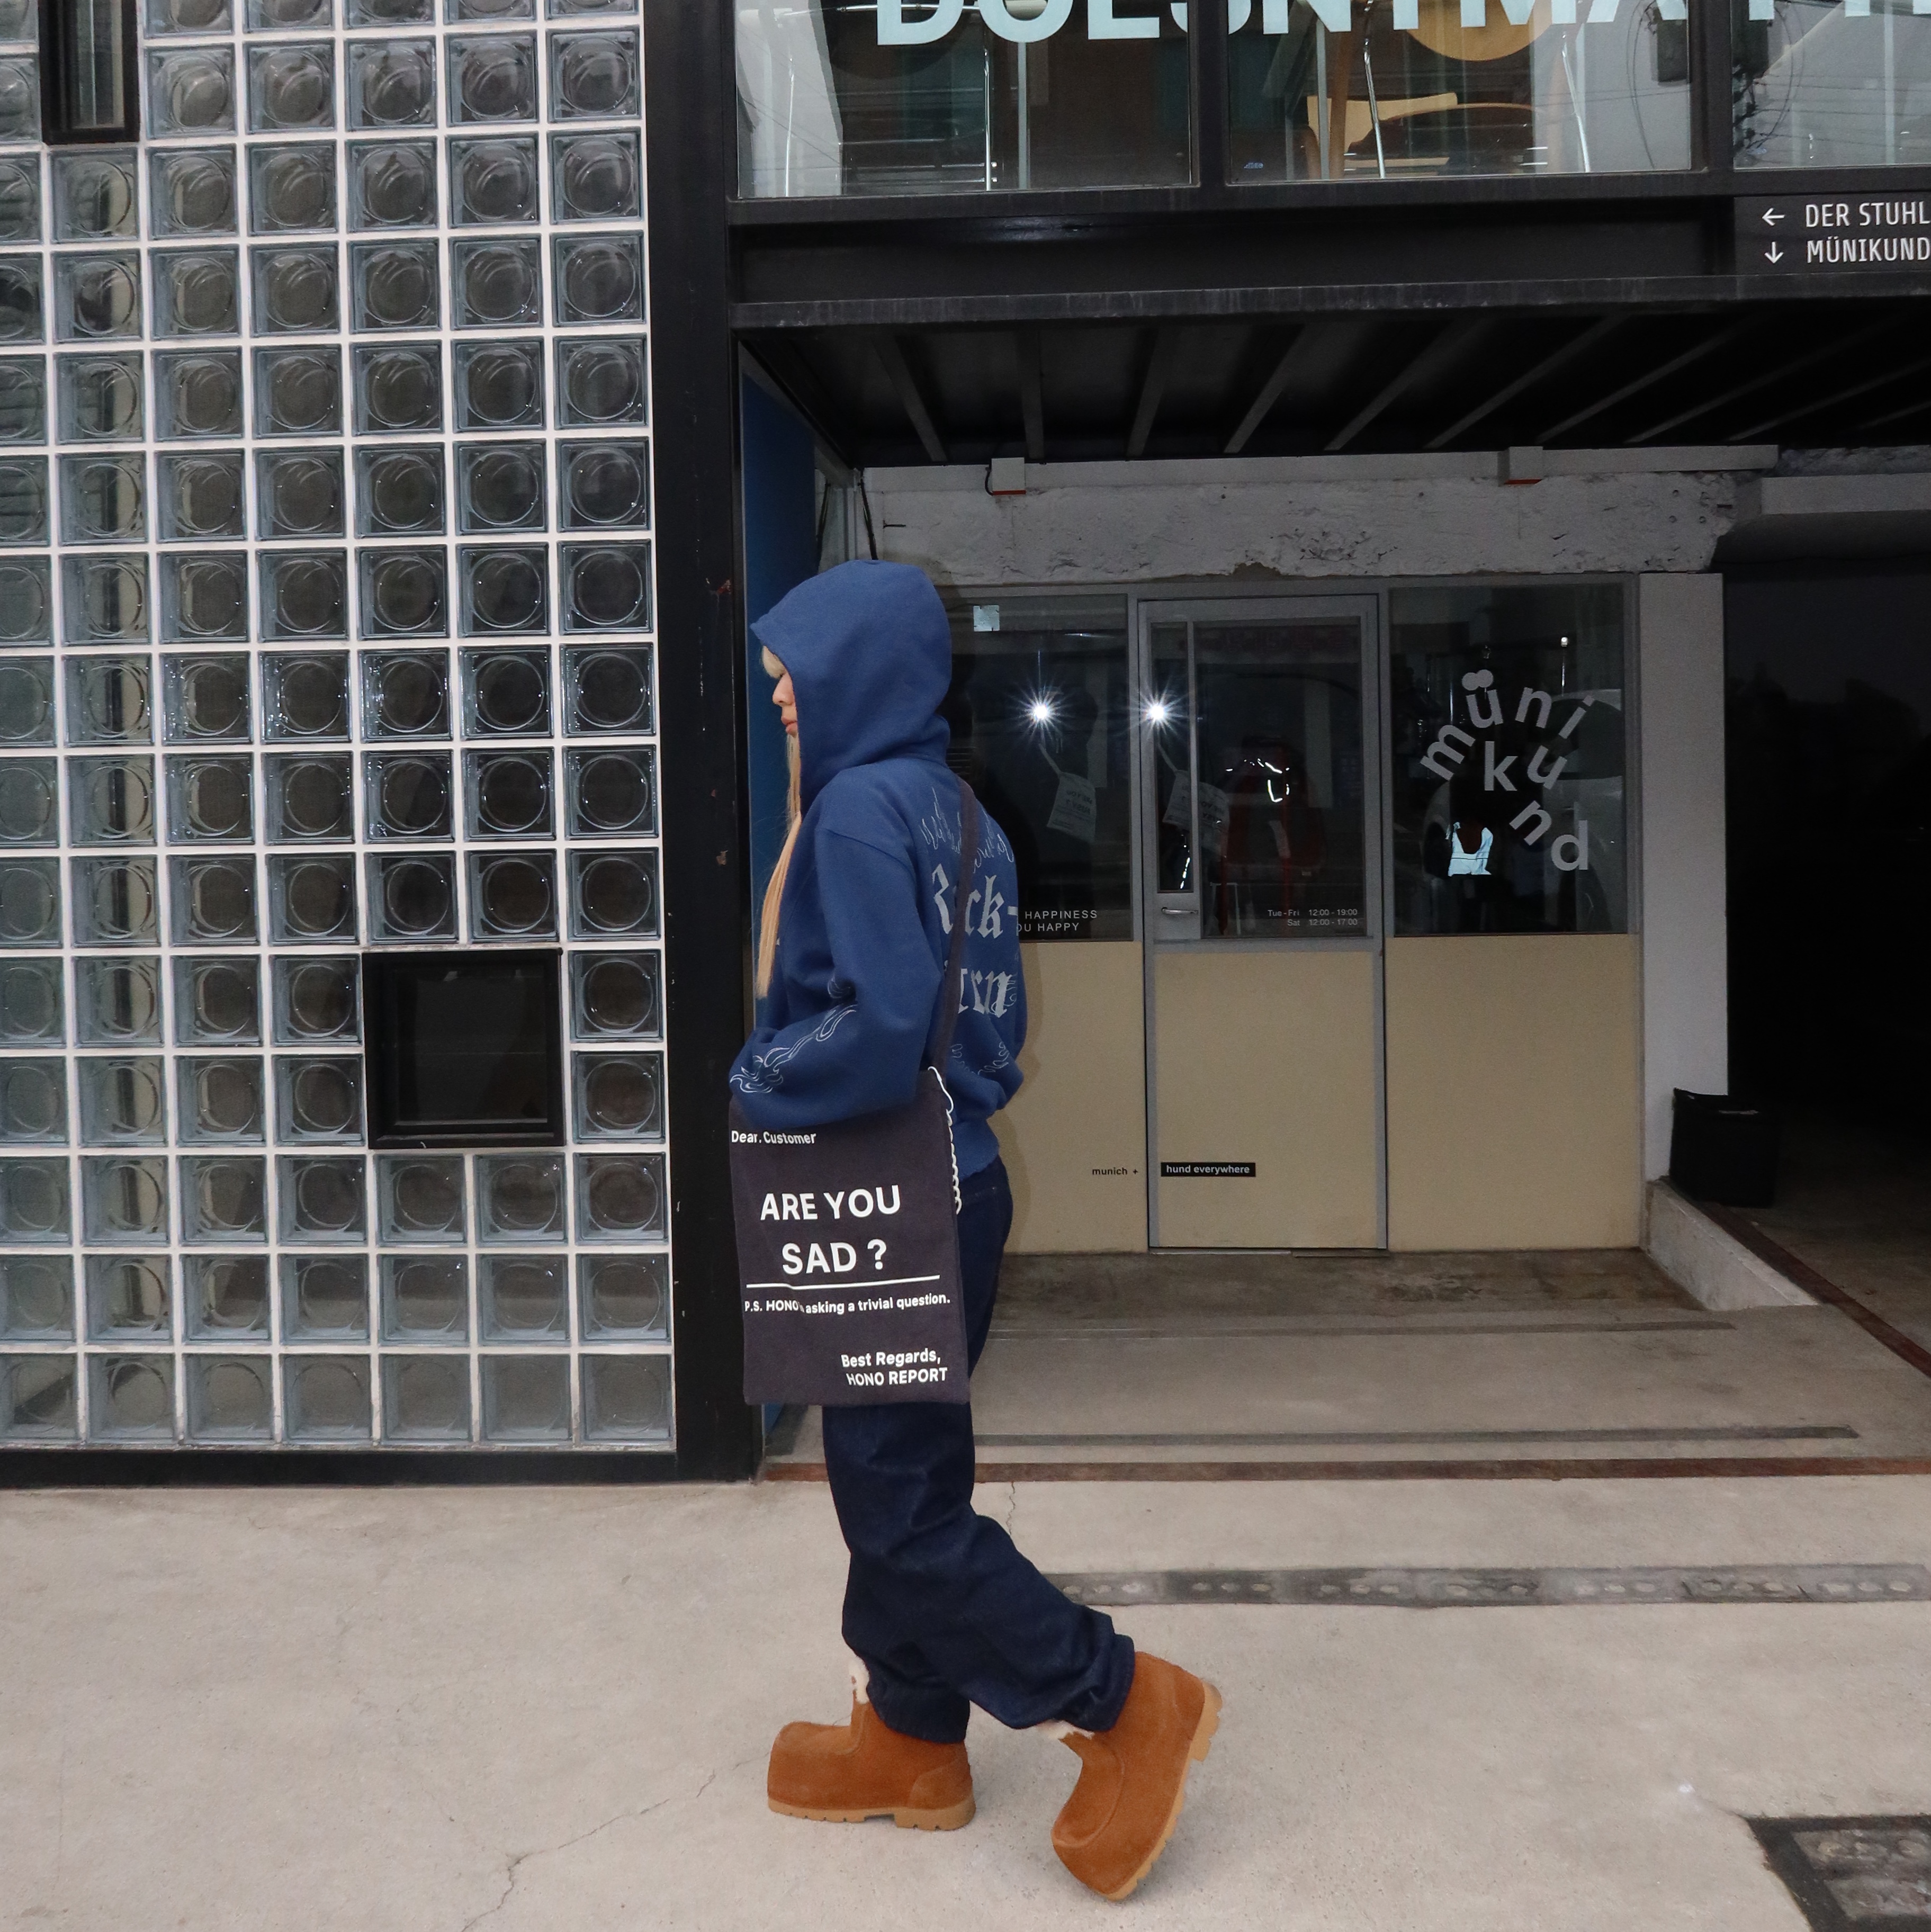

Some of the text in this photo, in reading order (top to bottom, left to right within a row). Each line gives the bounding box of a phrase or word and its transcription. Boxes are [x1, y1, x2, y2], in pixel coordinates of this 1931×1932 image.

[1806, 201, 1930, 227] DER STUHL
[1807, 236, 1930, 263] MÜNIKUND
[1025, 910, 1097, 919] HAPPINESS
[1038, 922, 1079, 931] HAPPY
[763, 1131, 816, 1144] Customer
[1092, 1167, 1128, 1175] munich
[1193, 1165, 1250, 1175] everywhere
[760, 1184, 901, 1220] ARE YOU
[782, 1238, 887, 1275] SAD ?
[744, 1300, 763, 1312] P.S.
[805, 1300, 845, 1315] asking
[848, 1302, 855, 1312] a
[857, 1297, 894, 1311] trivial
[896, 1292, 950, 1310] question.
[841, 1347, 941, 1368] Best Regards,
[846, 1365, 948, 1386] HONO REPORT
